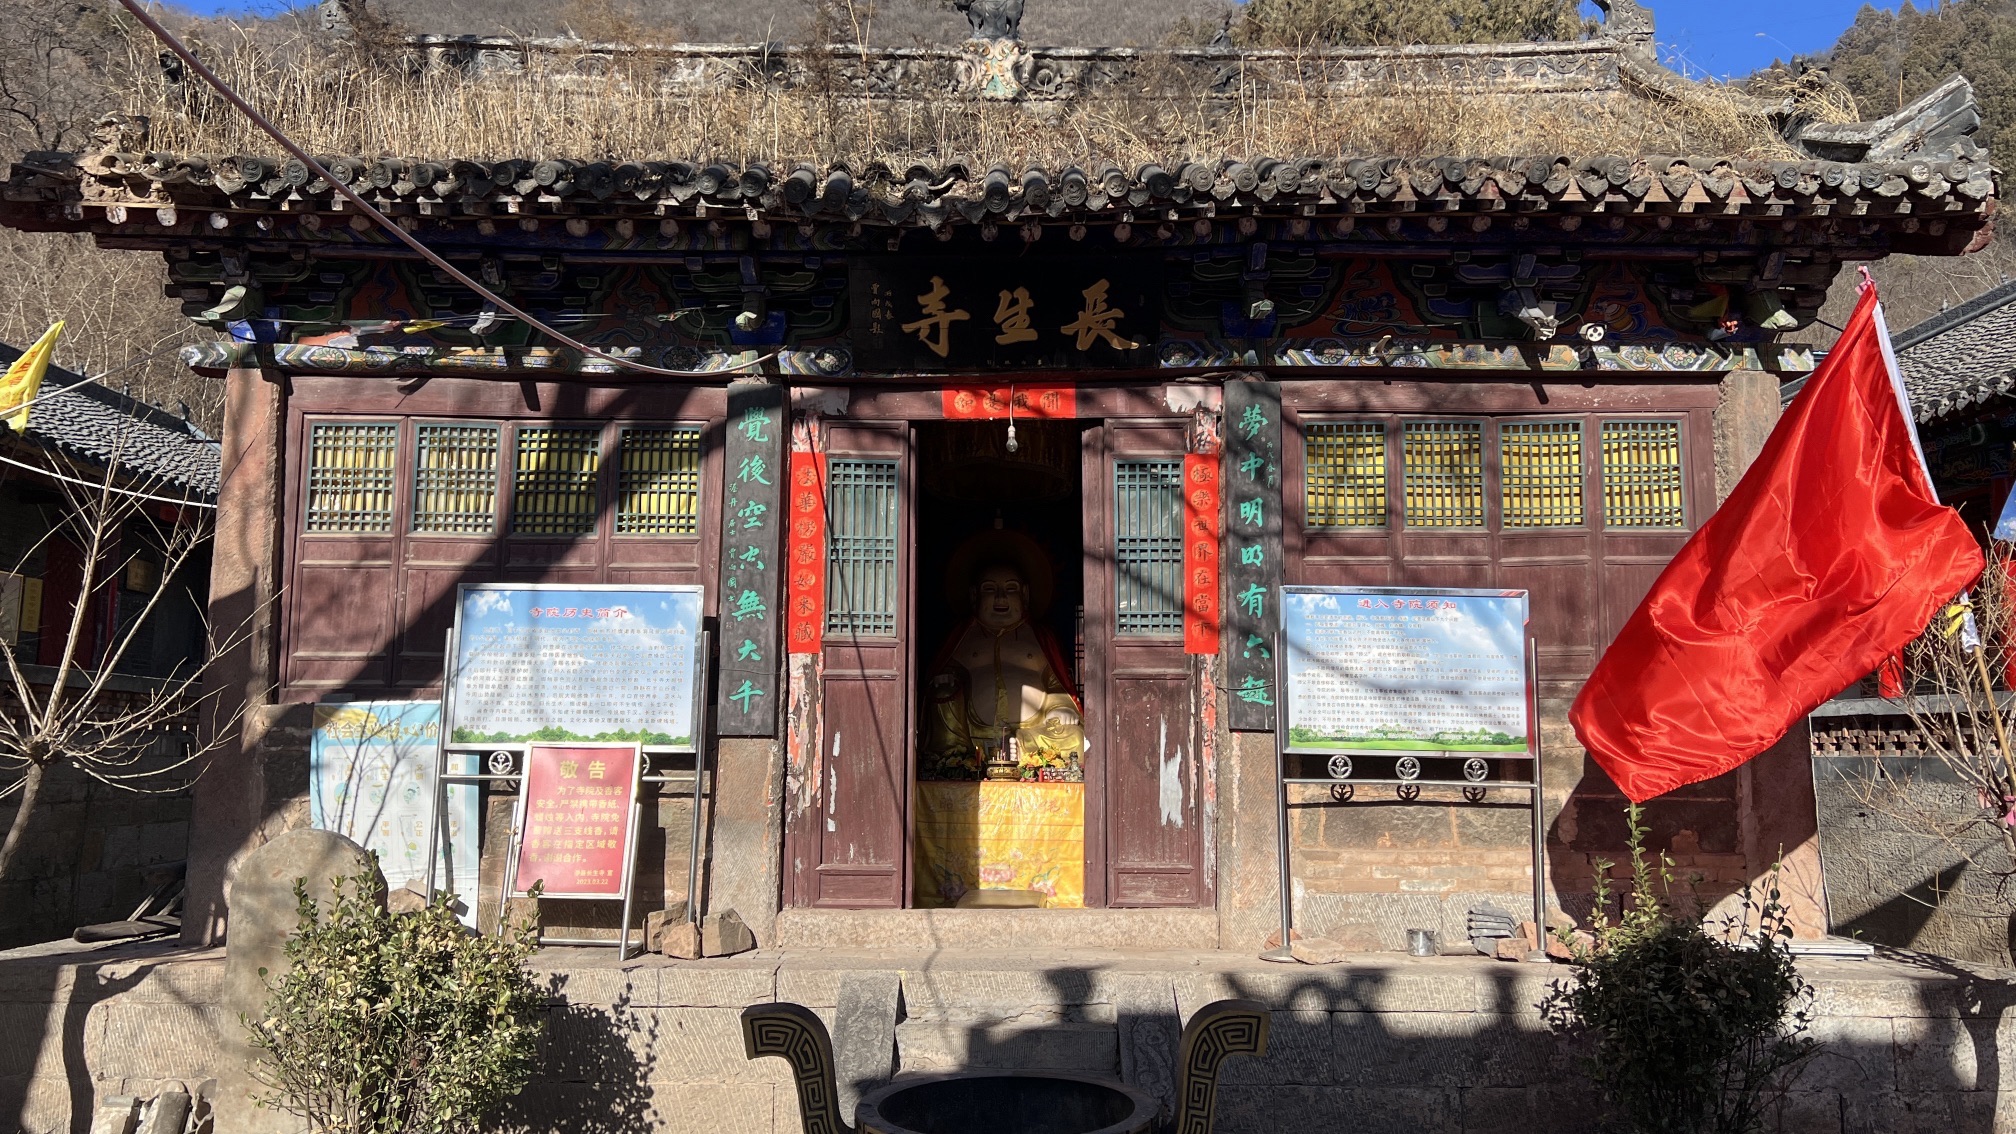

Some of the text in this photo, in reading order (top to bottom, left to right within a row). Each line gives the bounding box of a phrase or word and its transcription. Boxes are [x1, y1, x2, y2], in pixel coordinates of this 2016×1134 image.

[1357, 598, 1457, 610] 进入寺院须知
[529, 607, 628, 619] 寺院历史简介
[559, 760, 607, 780] 敬告
[557, 785, 624, 797] 为了寺院及香客
